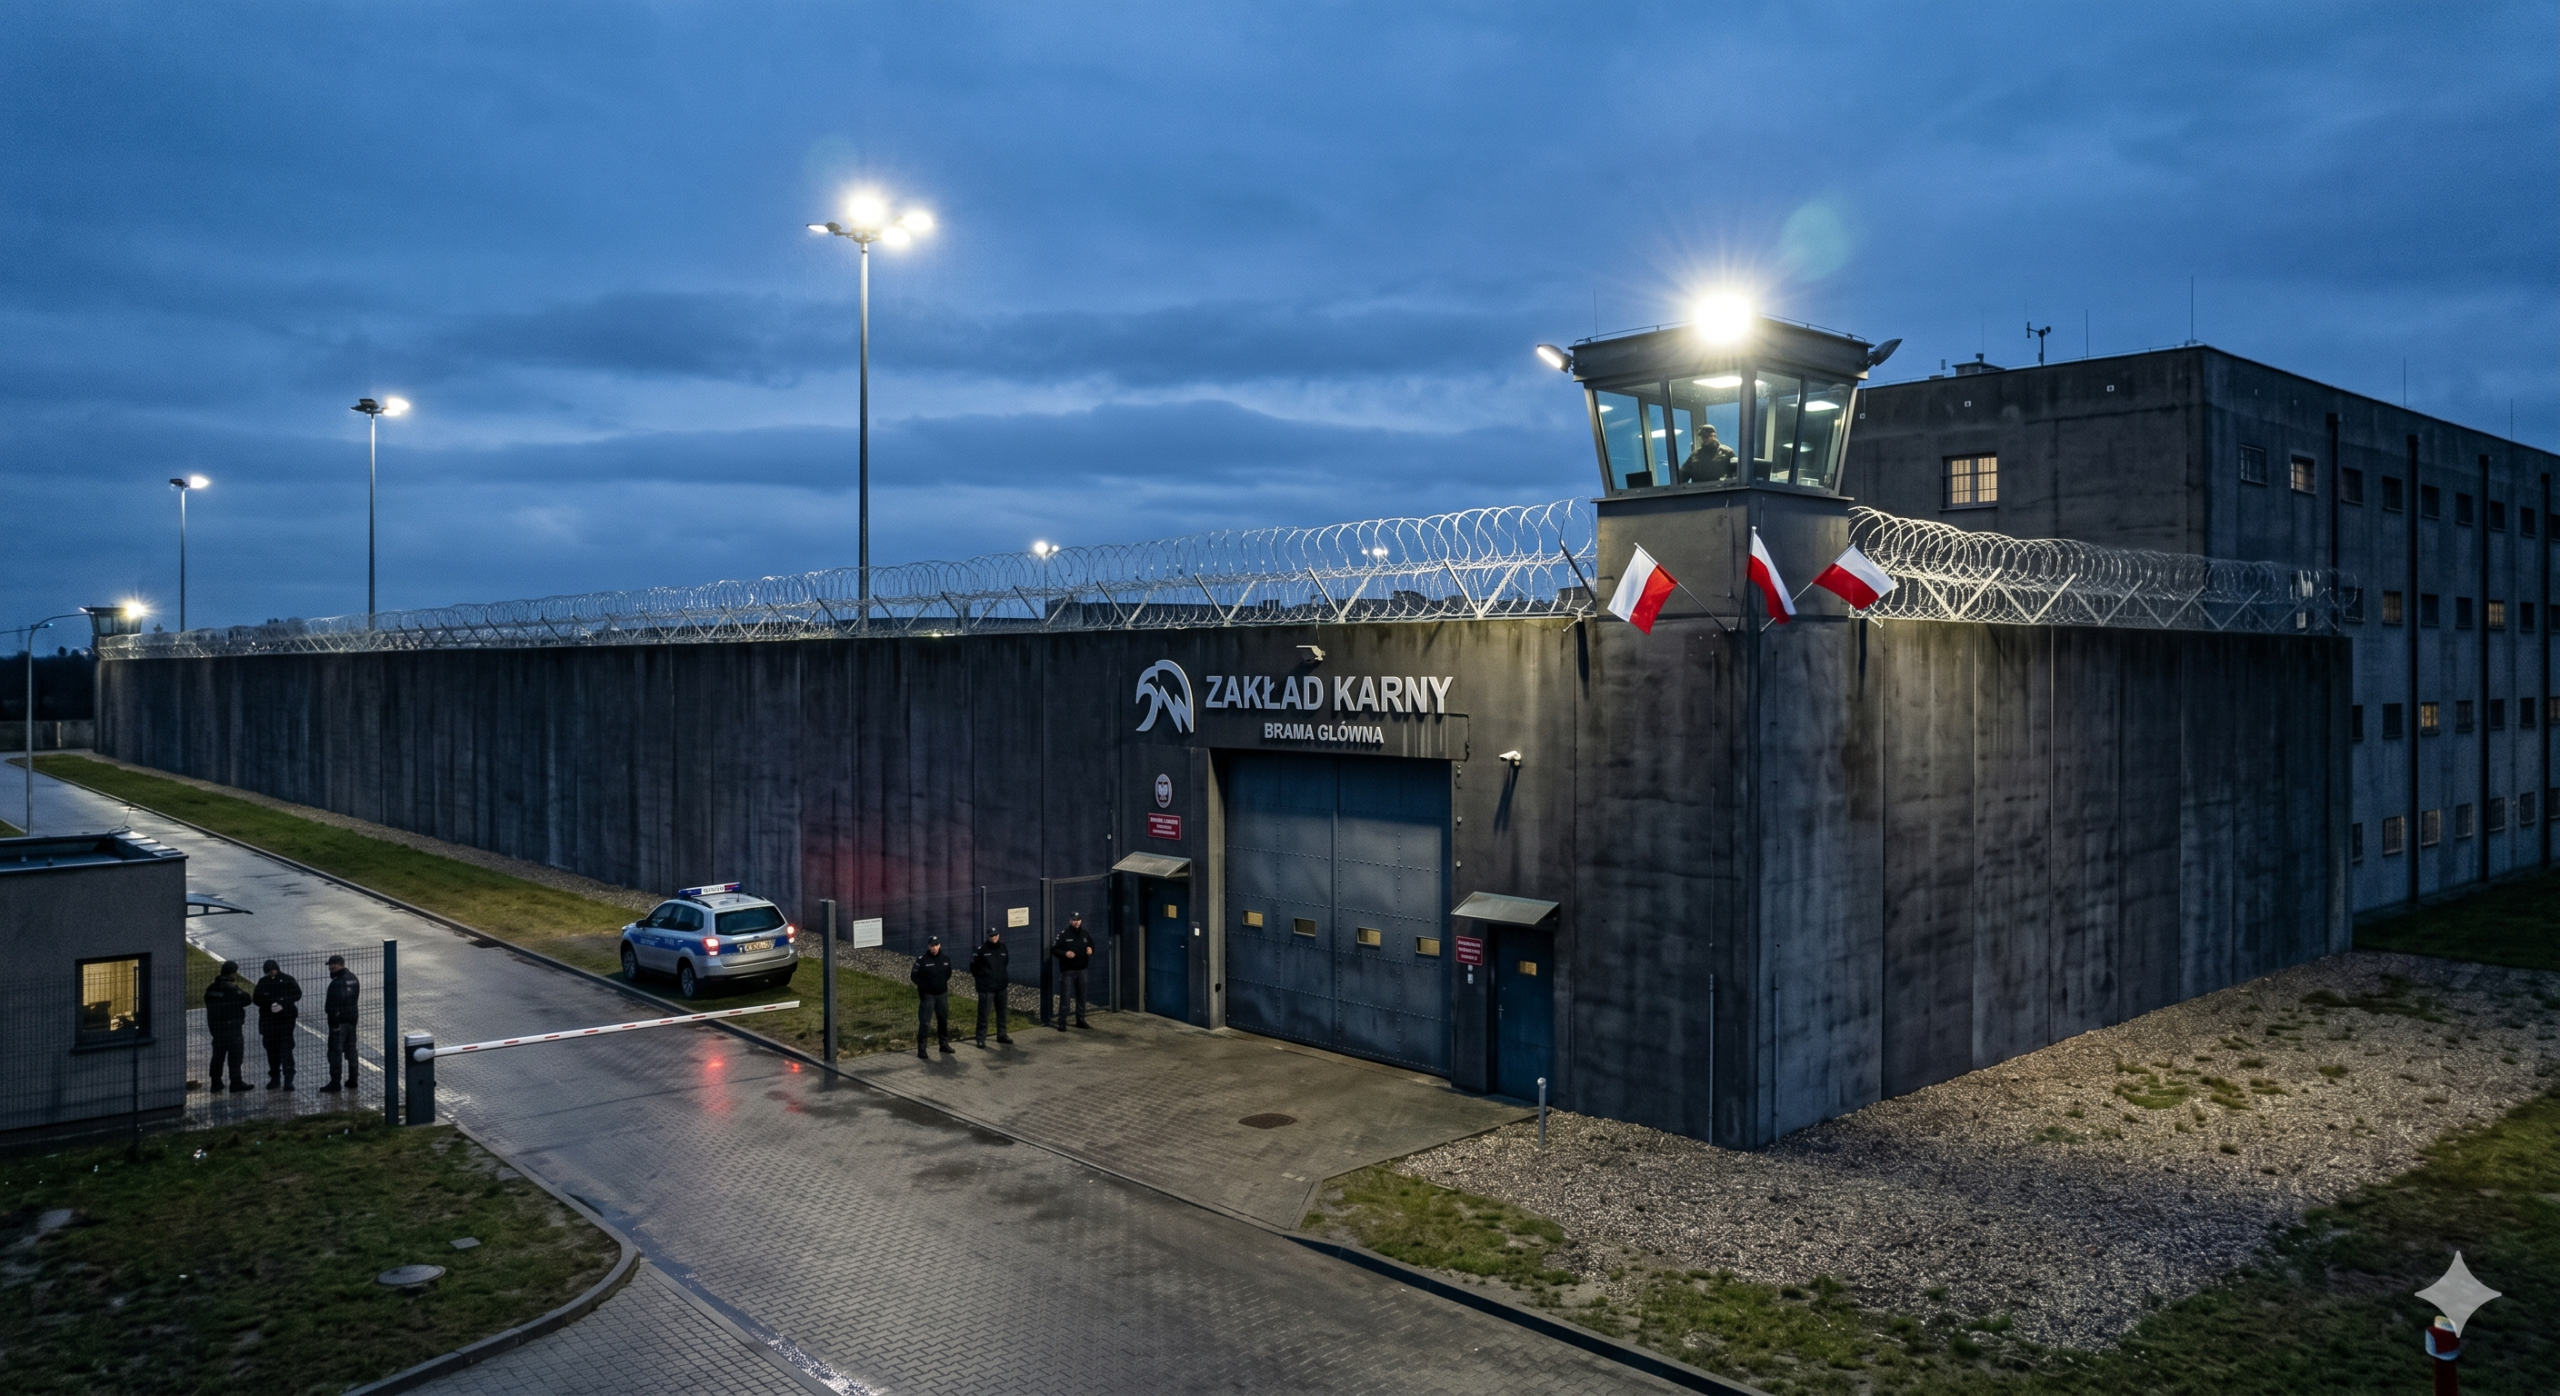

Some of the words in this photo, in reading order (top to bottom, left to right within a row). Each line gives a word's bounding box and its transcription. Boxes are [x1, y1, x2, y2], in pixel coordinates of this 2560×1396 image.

[1205, 675, 1324, 711] ZAKŁAD
[1334, 676, 1454, 714] KARNY
[1264, 722, 1315, 740] BRAMA
[1317, 720, 1385, 744] GLÓWNA
